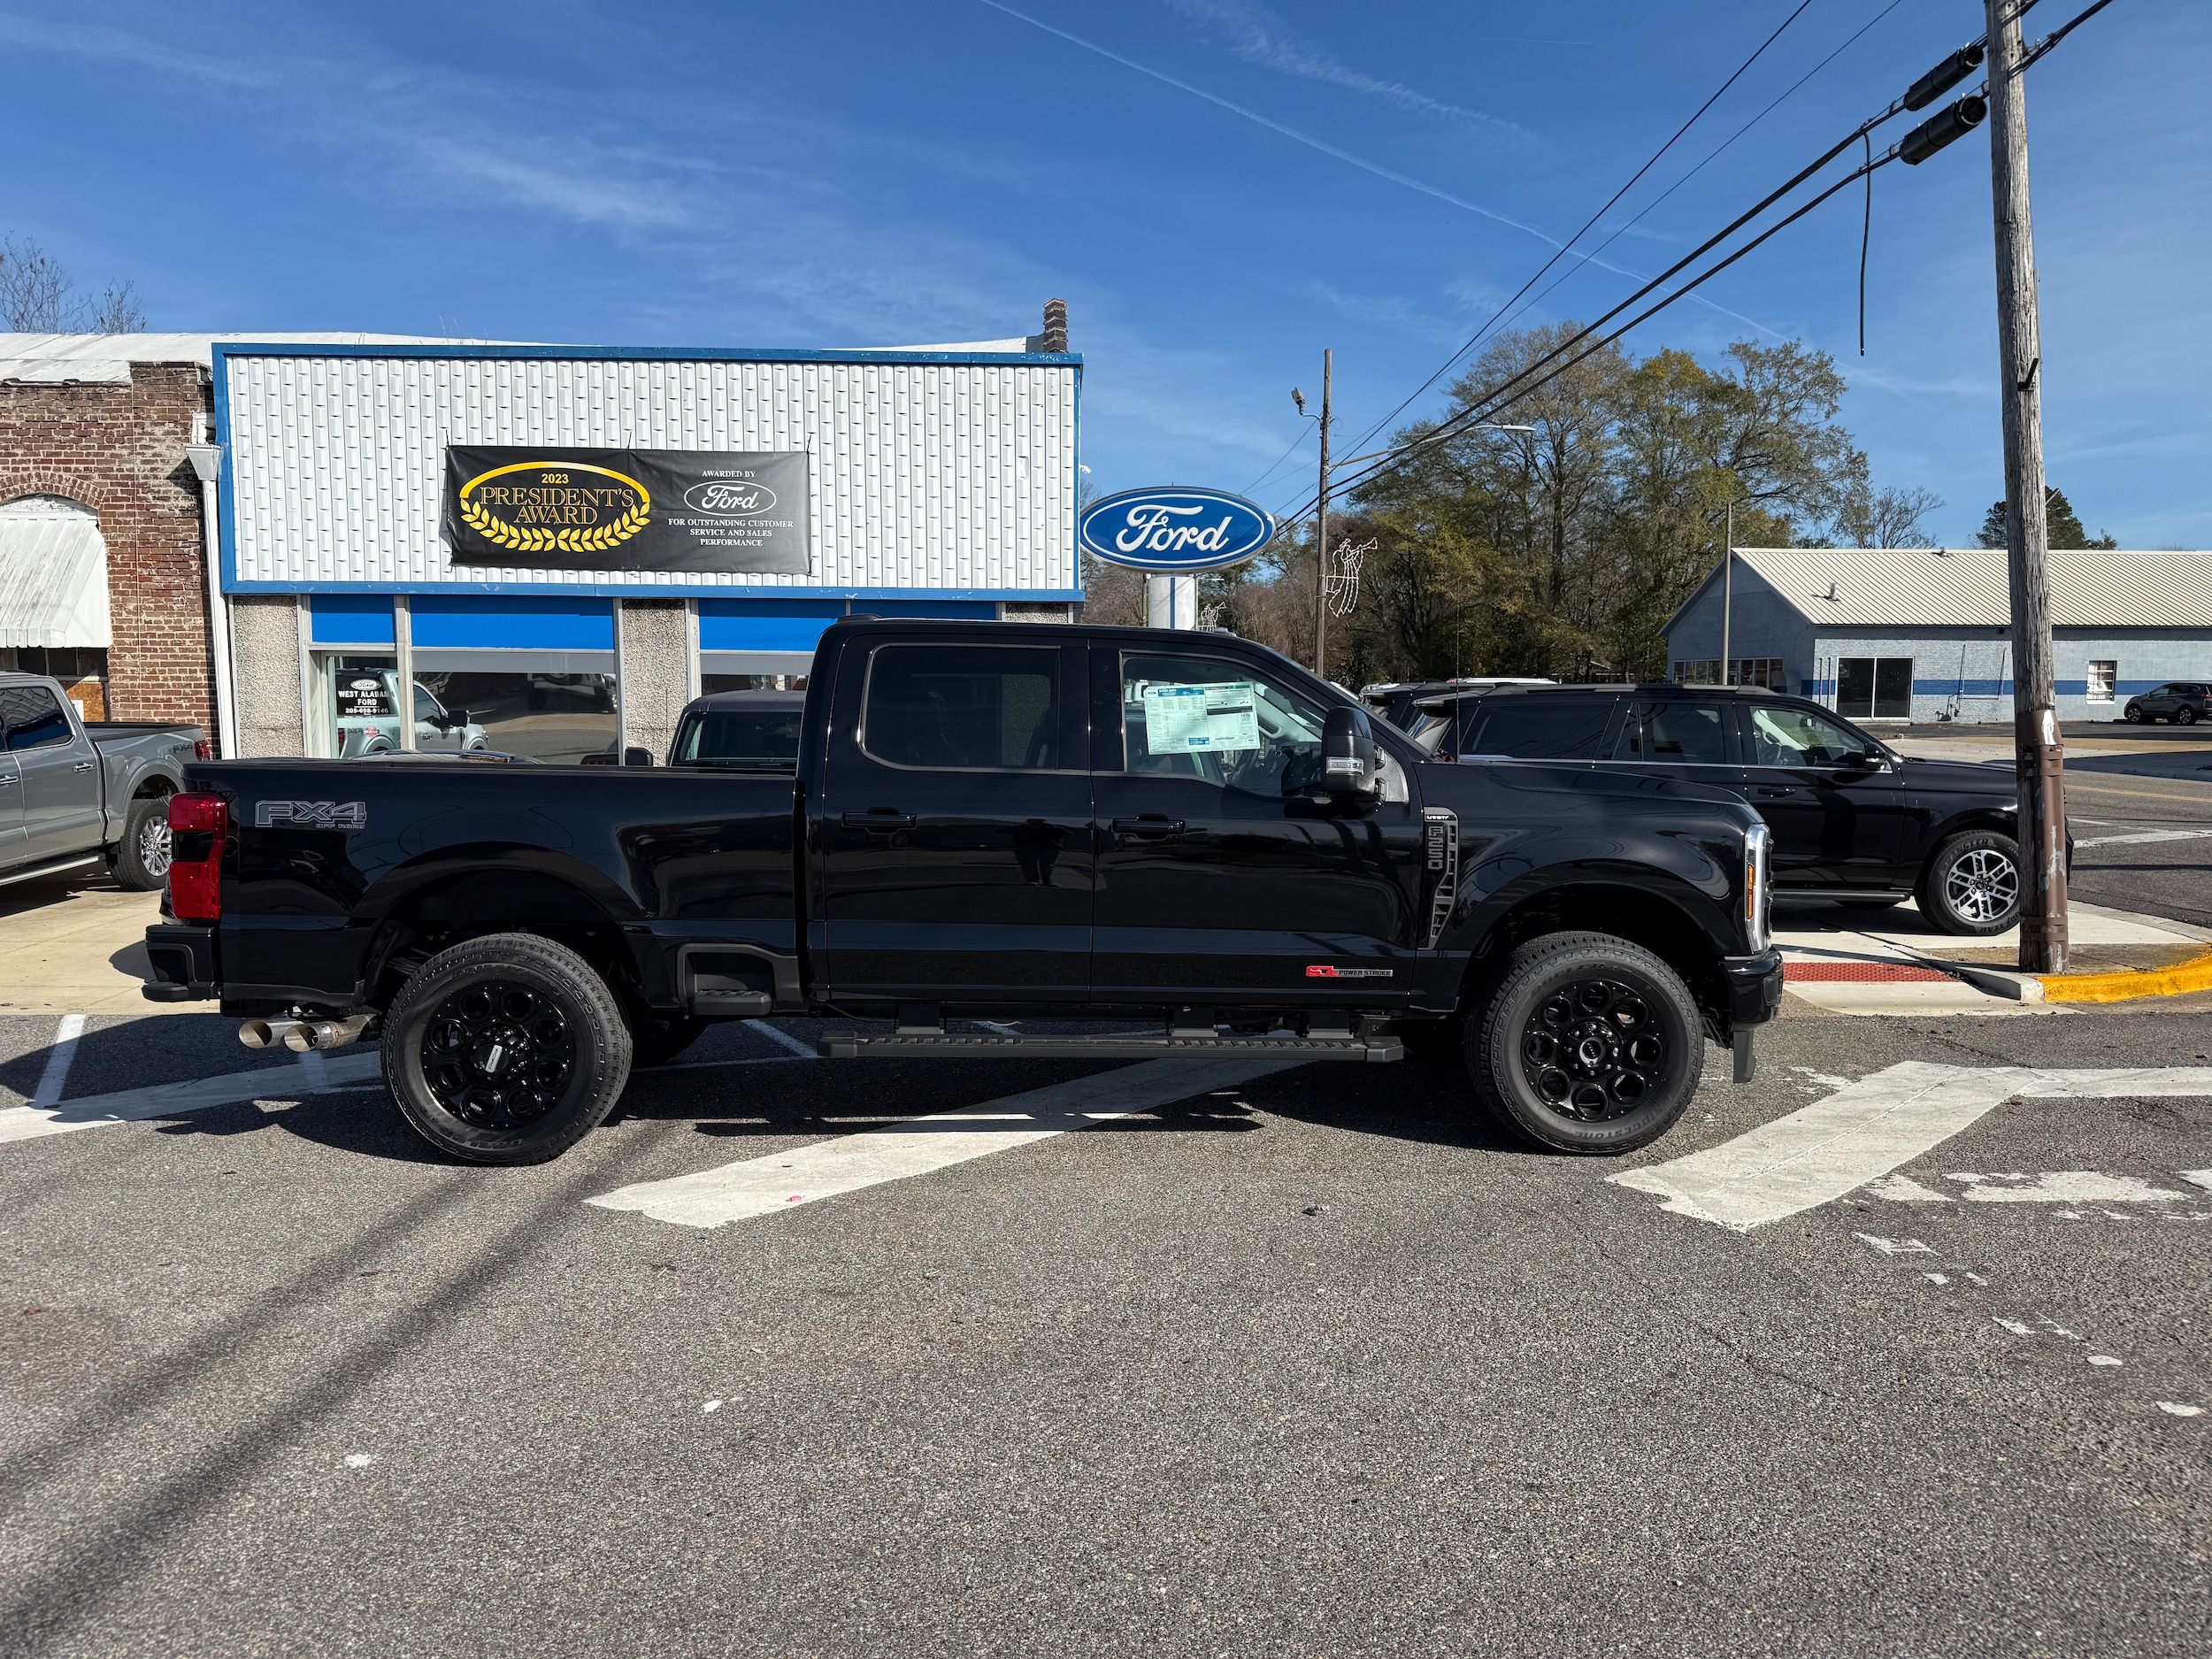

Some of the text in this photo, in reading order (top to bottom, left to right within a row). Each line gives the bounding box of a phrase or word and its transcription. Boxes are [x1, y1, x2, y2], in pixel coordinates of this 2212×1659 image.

[541, 473, 570, 484] 2023
[480, 487, 634, 508] PRESIDENT'S
[701, 485, 759, 510] Ford
[513, 506, 598, 525] AWARD
[687, 518, 746, 527] OUTSTANDING
[748, 519, 795, 528] CUSTOMER
[1115, 503, 1233, 552] Ford
[255, 800, 367, 827] FX4
[1939, 838, 1989, 871] WRANGLER
